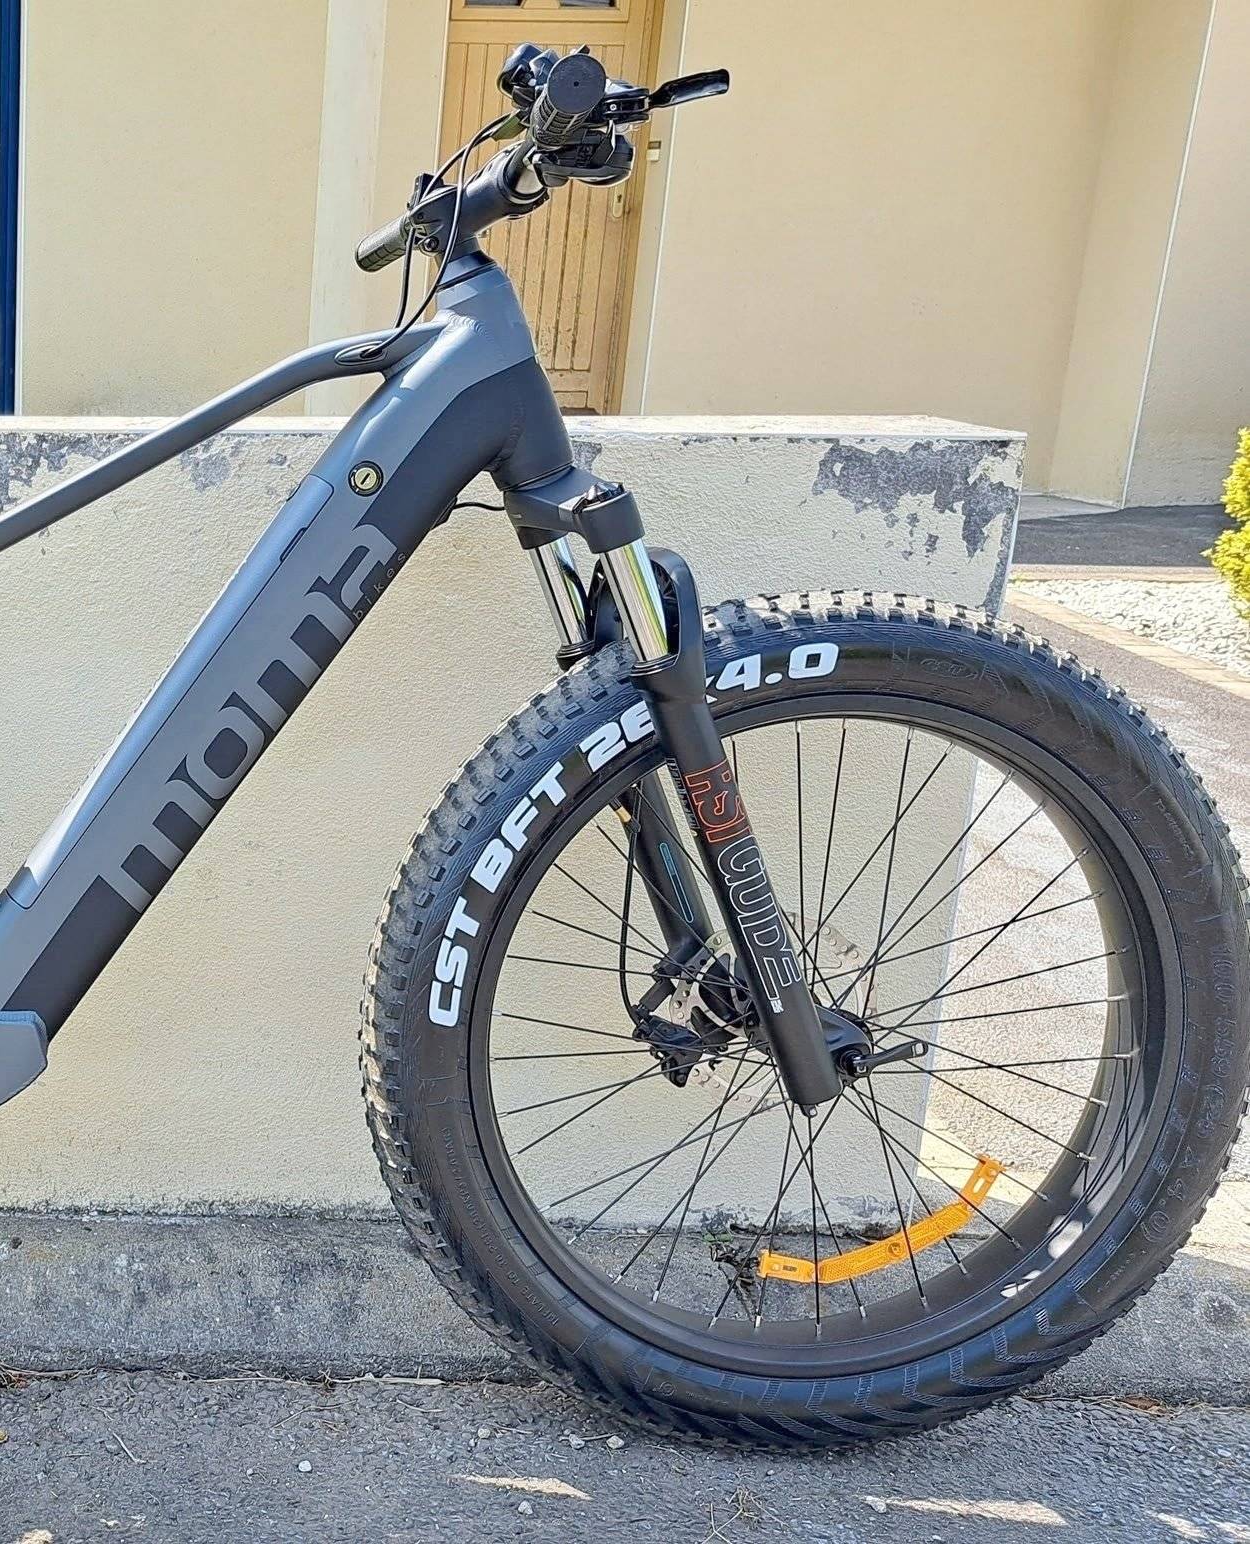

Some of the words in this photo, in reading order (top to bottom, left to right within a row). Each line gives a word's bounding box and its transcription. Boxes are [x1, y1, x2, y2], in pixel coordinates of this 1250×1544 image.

[352, 552, 407, 621] bikes
[98, 523, 399, 915] moma
[427, 895, 481, 1028] CST
[469, 761, 567, 894] BFT
[717, 832, 803, 1001] GUIDE
